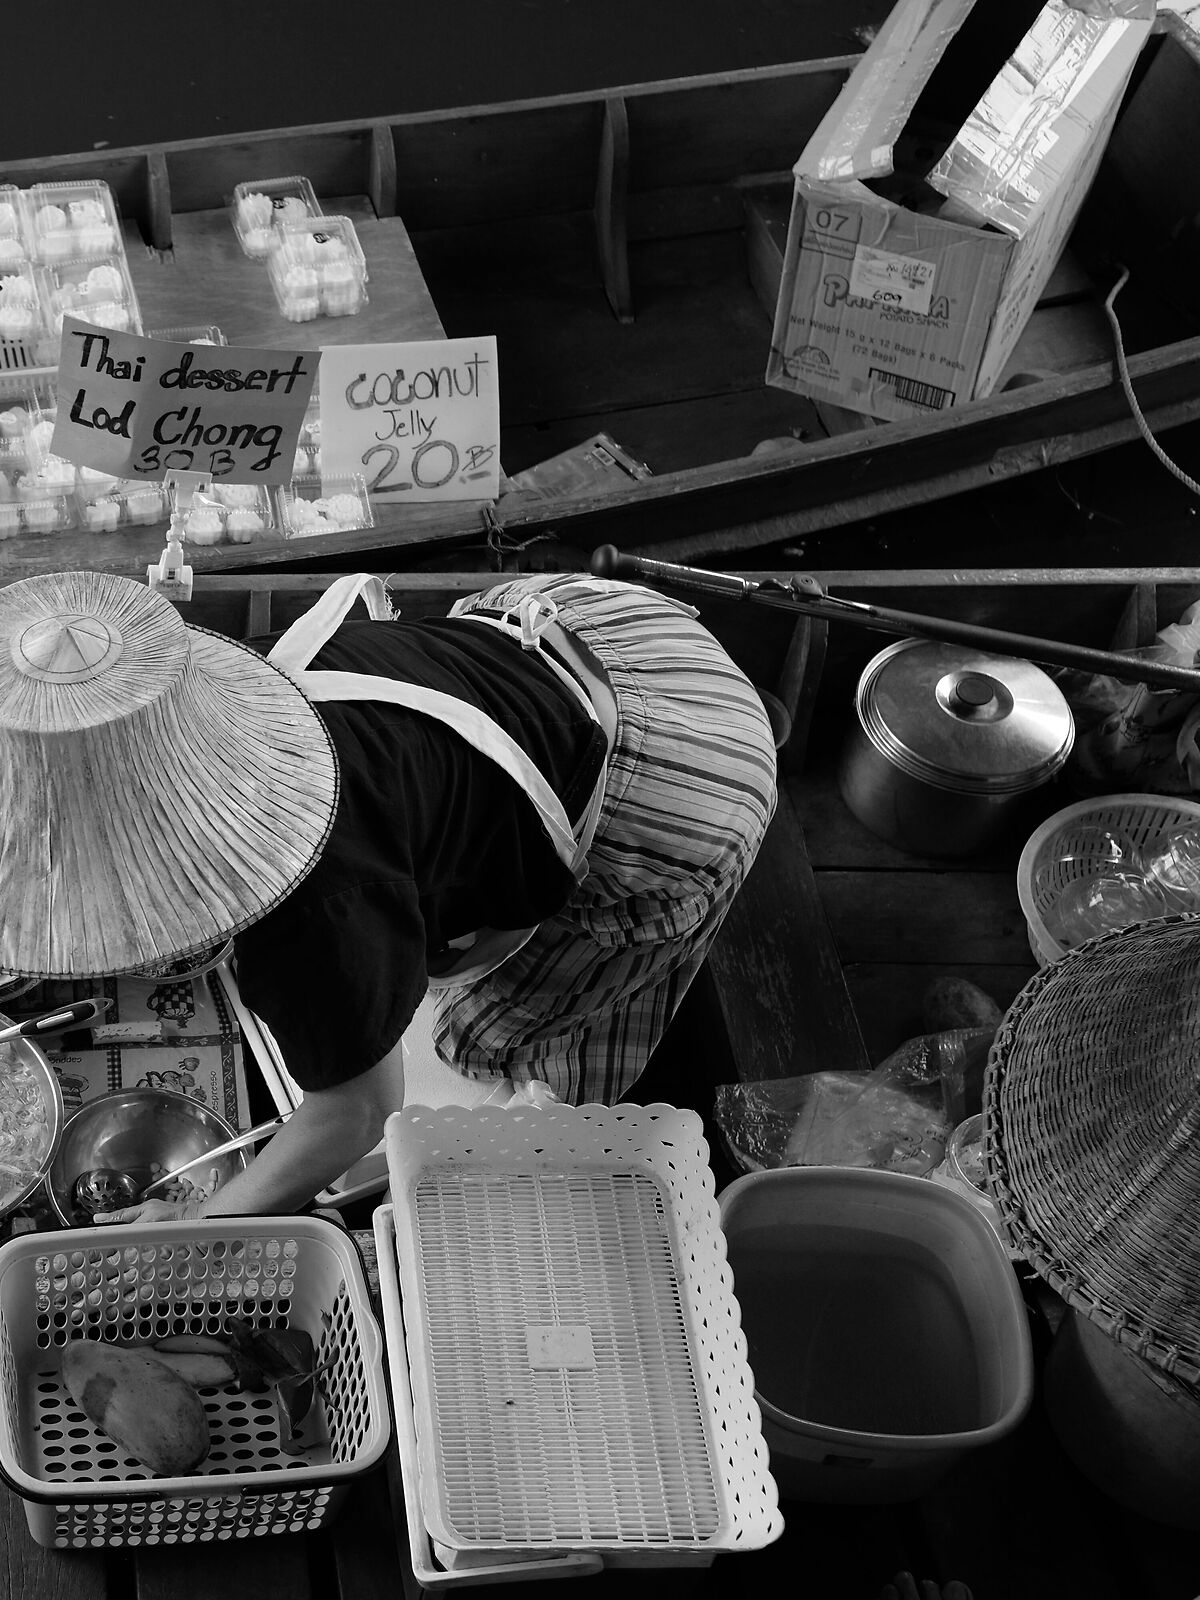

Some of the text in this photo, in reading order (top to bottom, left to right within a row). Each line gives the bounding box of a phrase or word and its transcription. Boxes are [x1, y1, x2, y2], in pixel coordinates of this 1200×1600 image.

[815, 209, 849, 232] 07
[71, 331, 307, 393] Thai dessert
[69, 388, 282, 472] Lod Chong
[375, 409, 437, 450] Jelly
[133, 445, 195, 473] 30
[49, 1055, 82, 1064] cappuc
[210, 1070, 219, 1111] espresso
